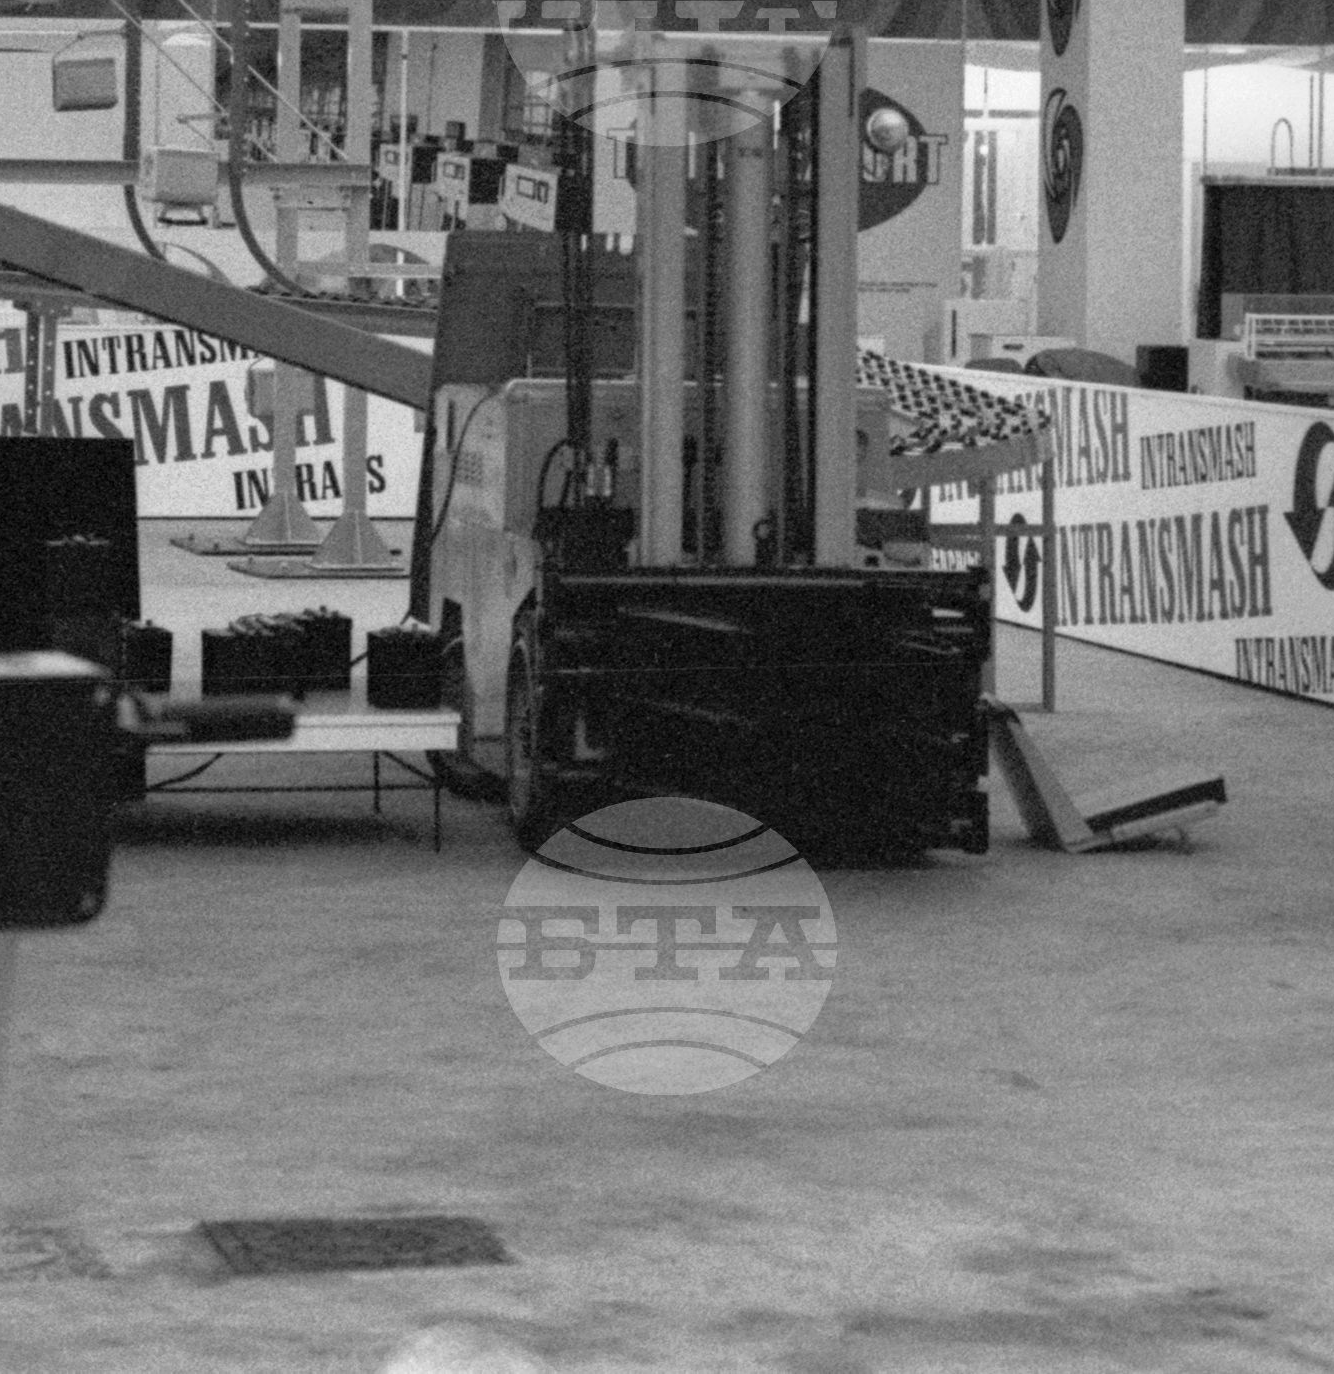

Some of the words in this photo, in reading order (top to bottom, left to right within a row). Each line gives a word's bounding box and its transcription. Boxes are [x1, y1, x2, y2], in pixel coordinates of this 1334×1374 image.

[233, 454, 386, 510] INRAS
[1140, 421, 1256, 490] INTRANSMASH
[1055, 504, 1272, 626] NTRANSMASH
